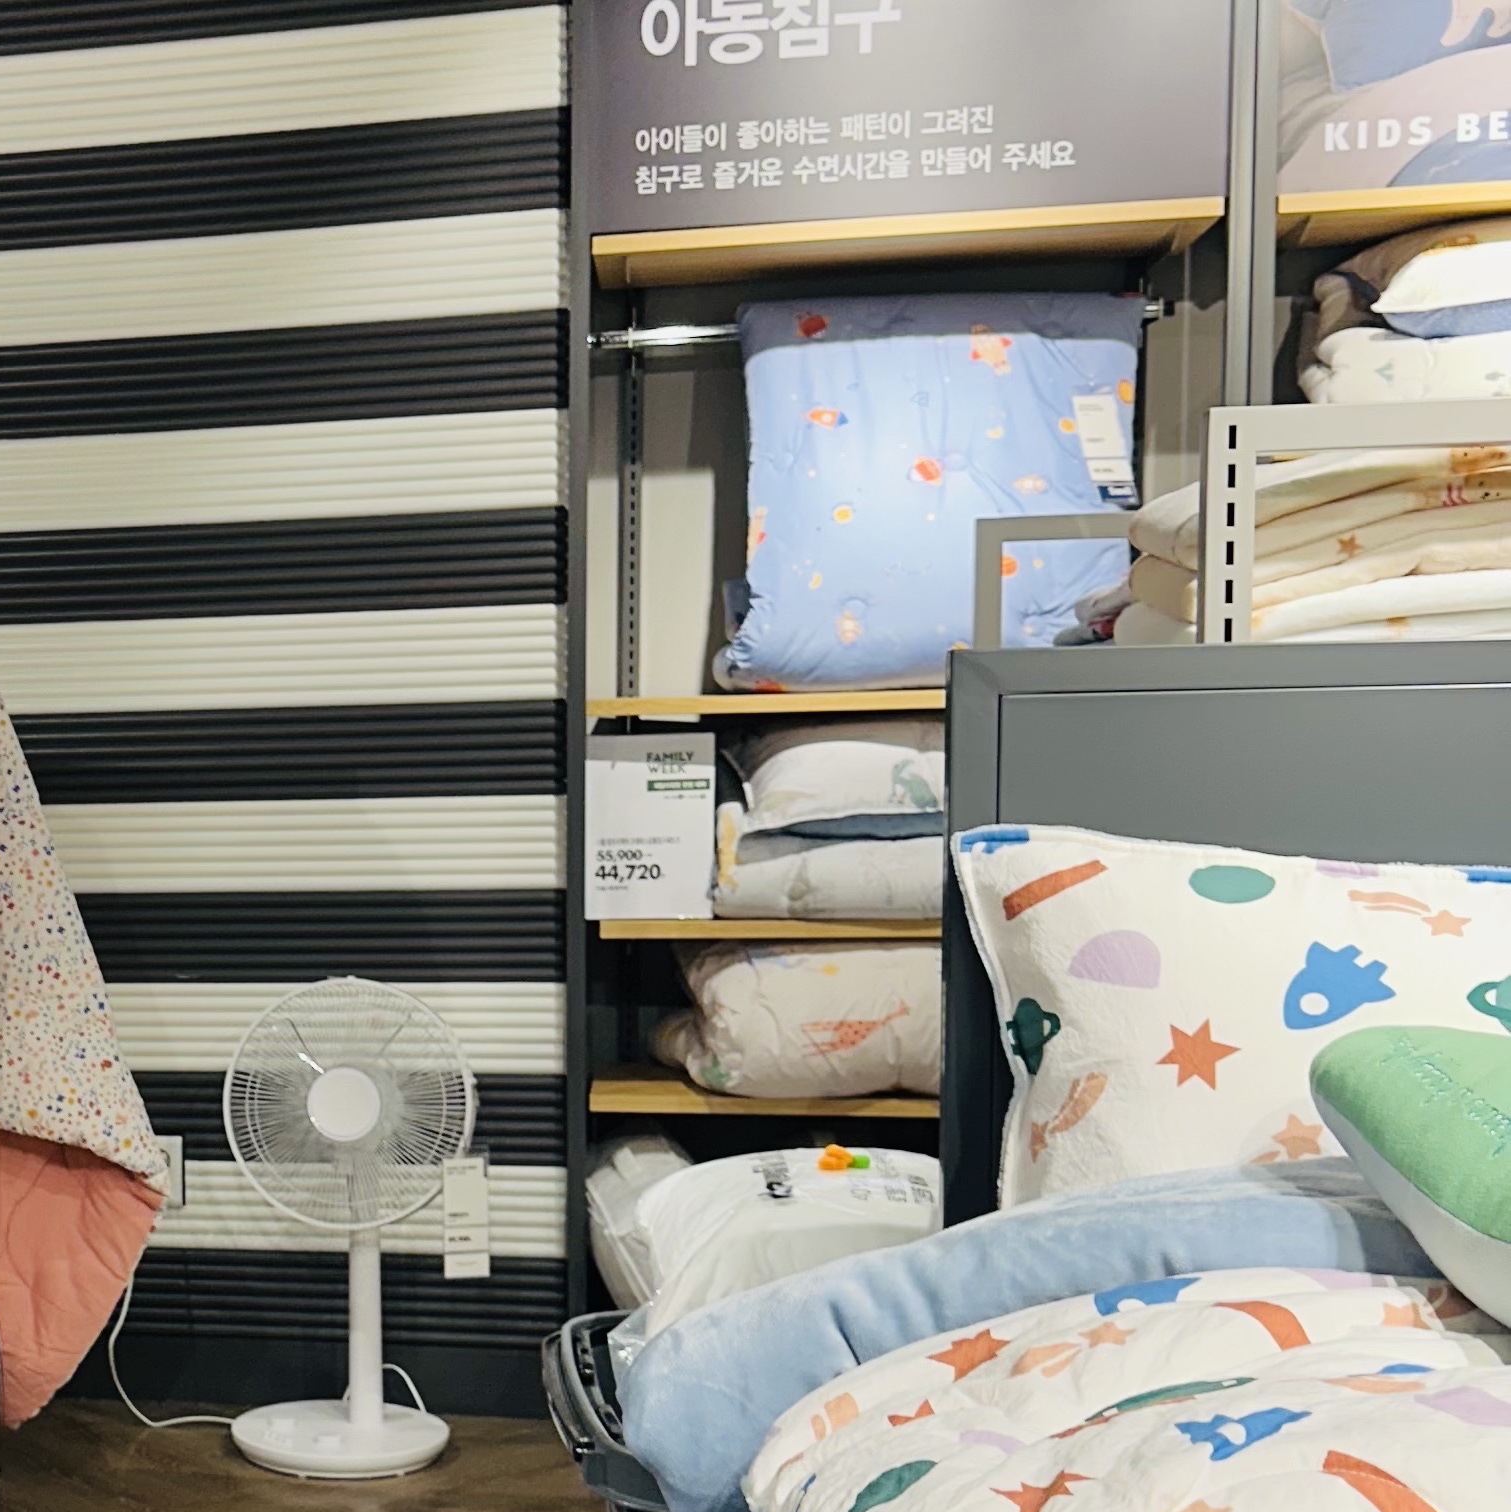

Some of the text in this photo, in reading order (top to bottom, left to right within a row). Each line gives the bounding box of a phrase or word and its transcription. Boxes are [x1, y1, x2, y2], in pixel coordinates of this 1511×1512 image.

[635, 104, 994, 155] 아이들이 좋아하는 패턴이 그려진
[1324, 116, 1433, 152] KIDS
[635, 140, 1076, 195] 침구로 즐거운 수면시간을 만들어 주세요
[646, 751, 694, 763] FAMILY
[648, 764, 687, 774] WEEK
[594, 863, 661, 883] 44,720
